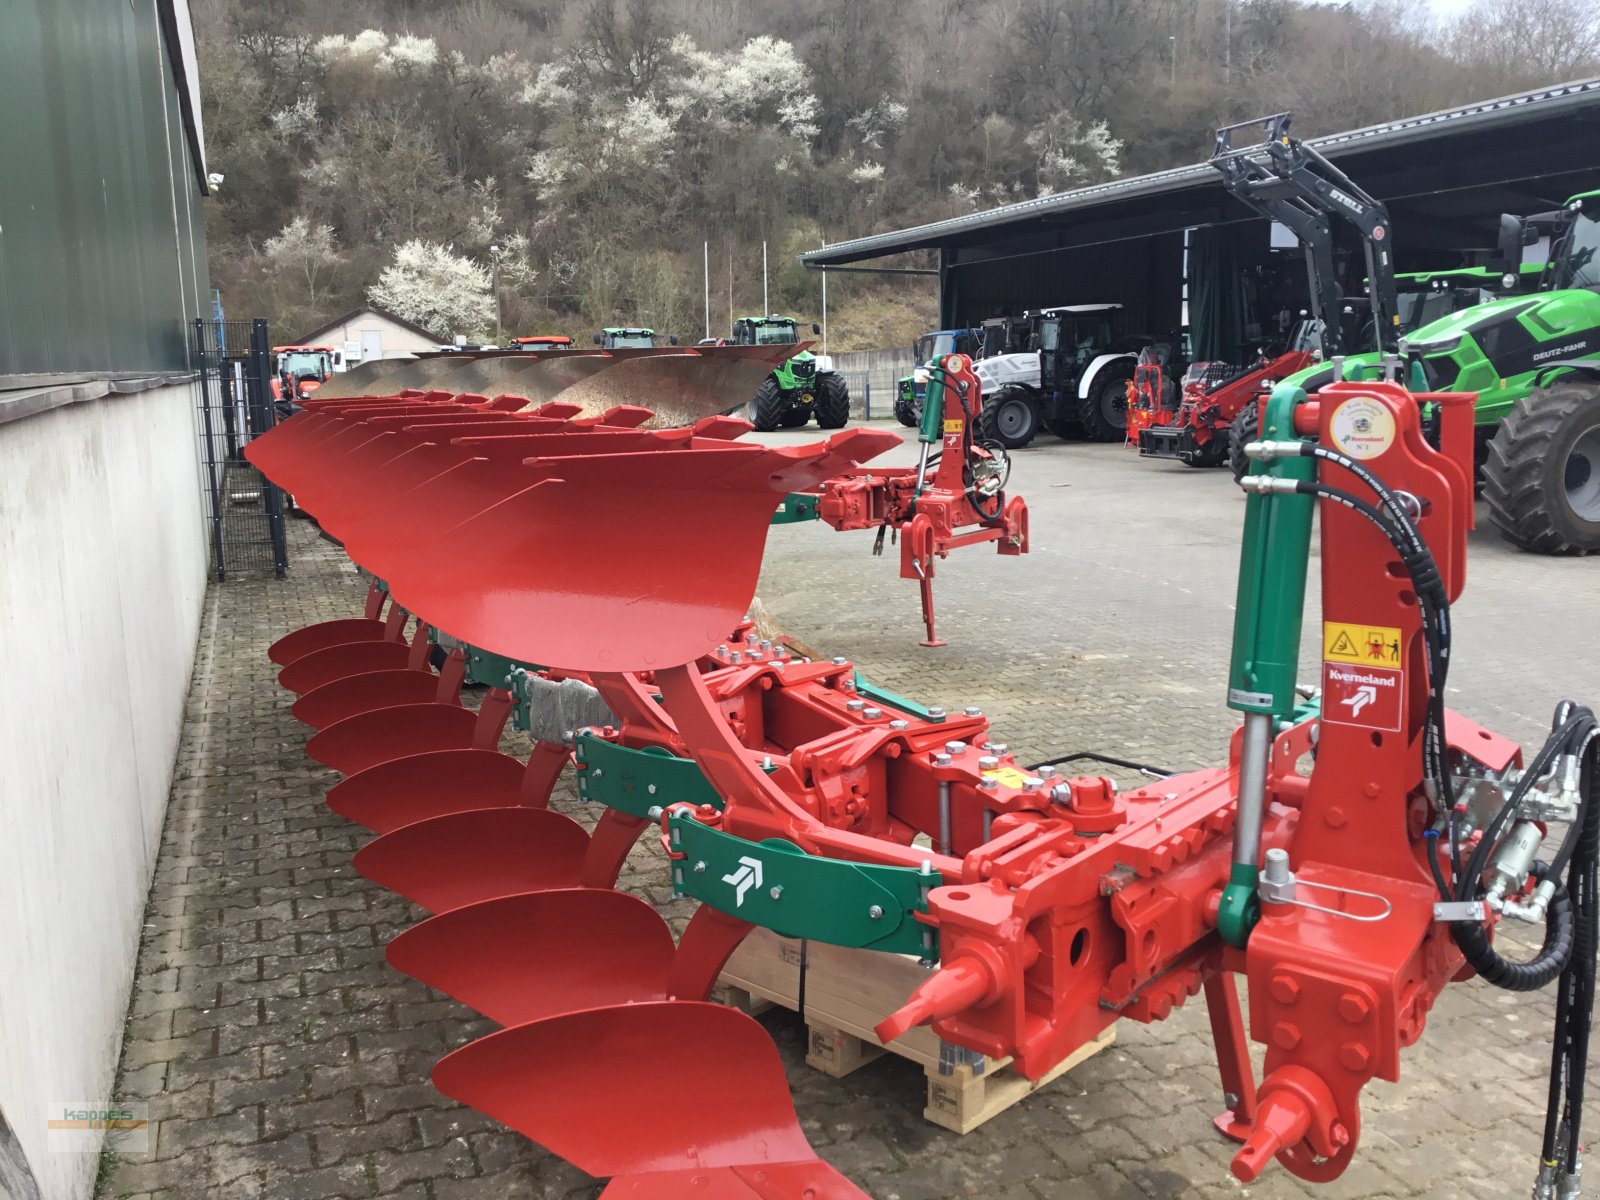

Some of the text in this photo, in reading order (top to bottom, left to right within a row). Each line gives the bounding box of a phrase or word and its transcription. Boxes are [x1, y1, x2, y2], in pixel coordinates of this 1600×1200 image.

[1329, 189, 1364, 214] STOLL
[1533, 341, 1587, 361] DEUTZ-FAHR
[1329, 669, 1396, 687] Kverneland
